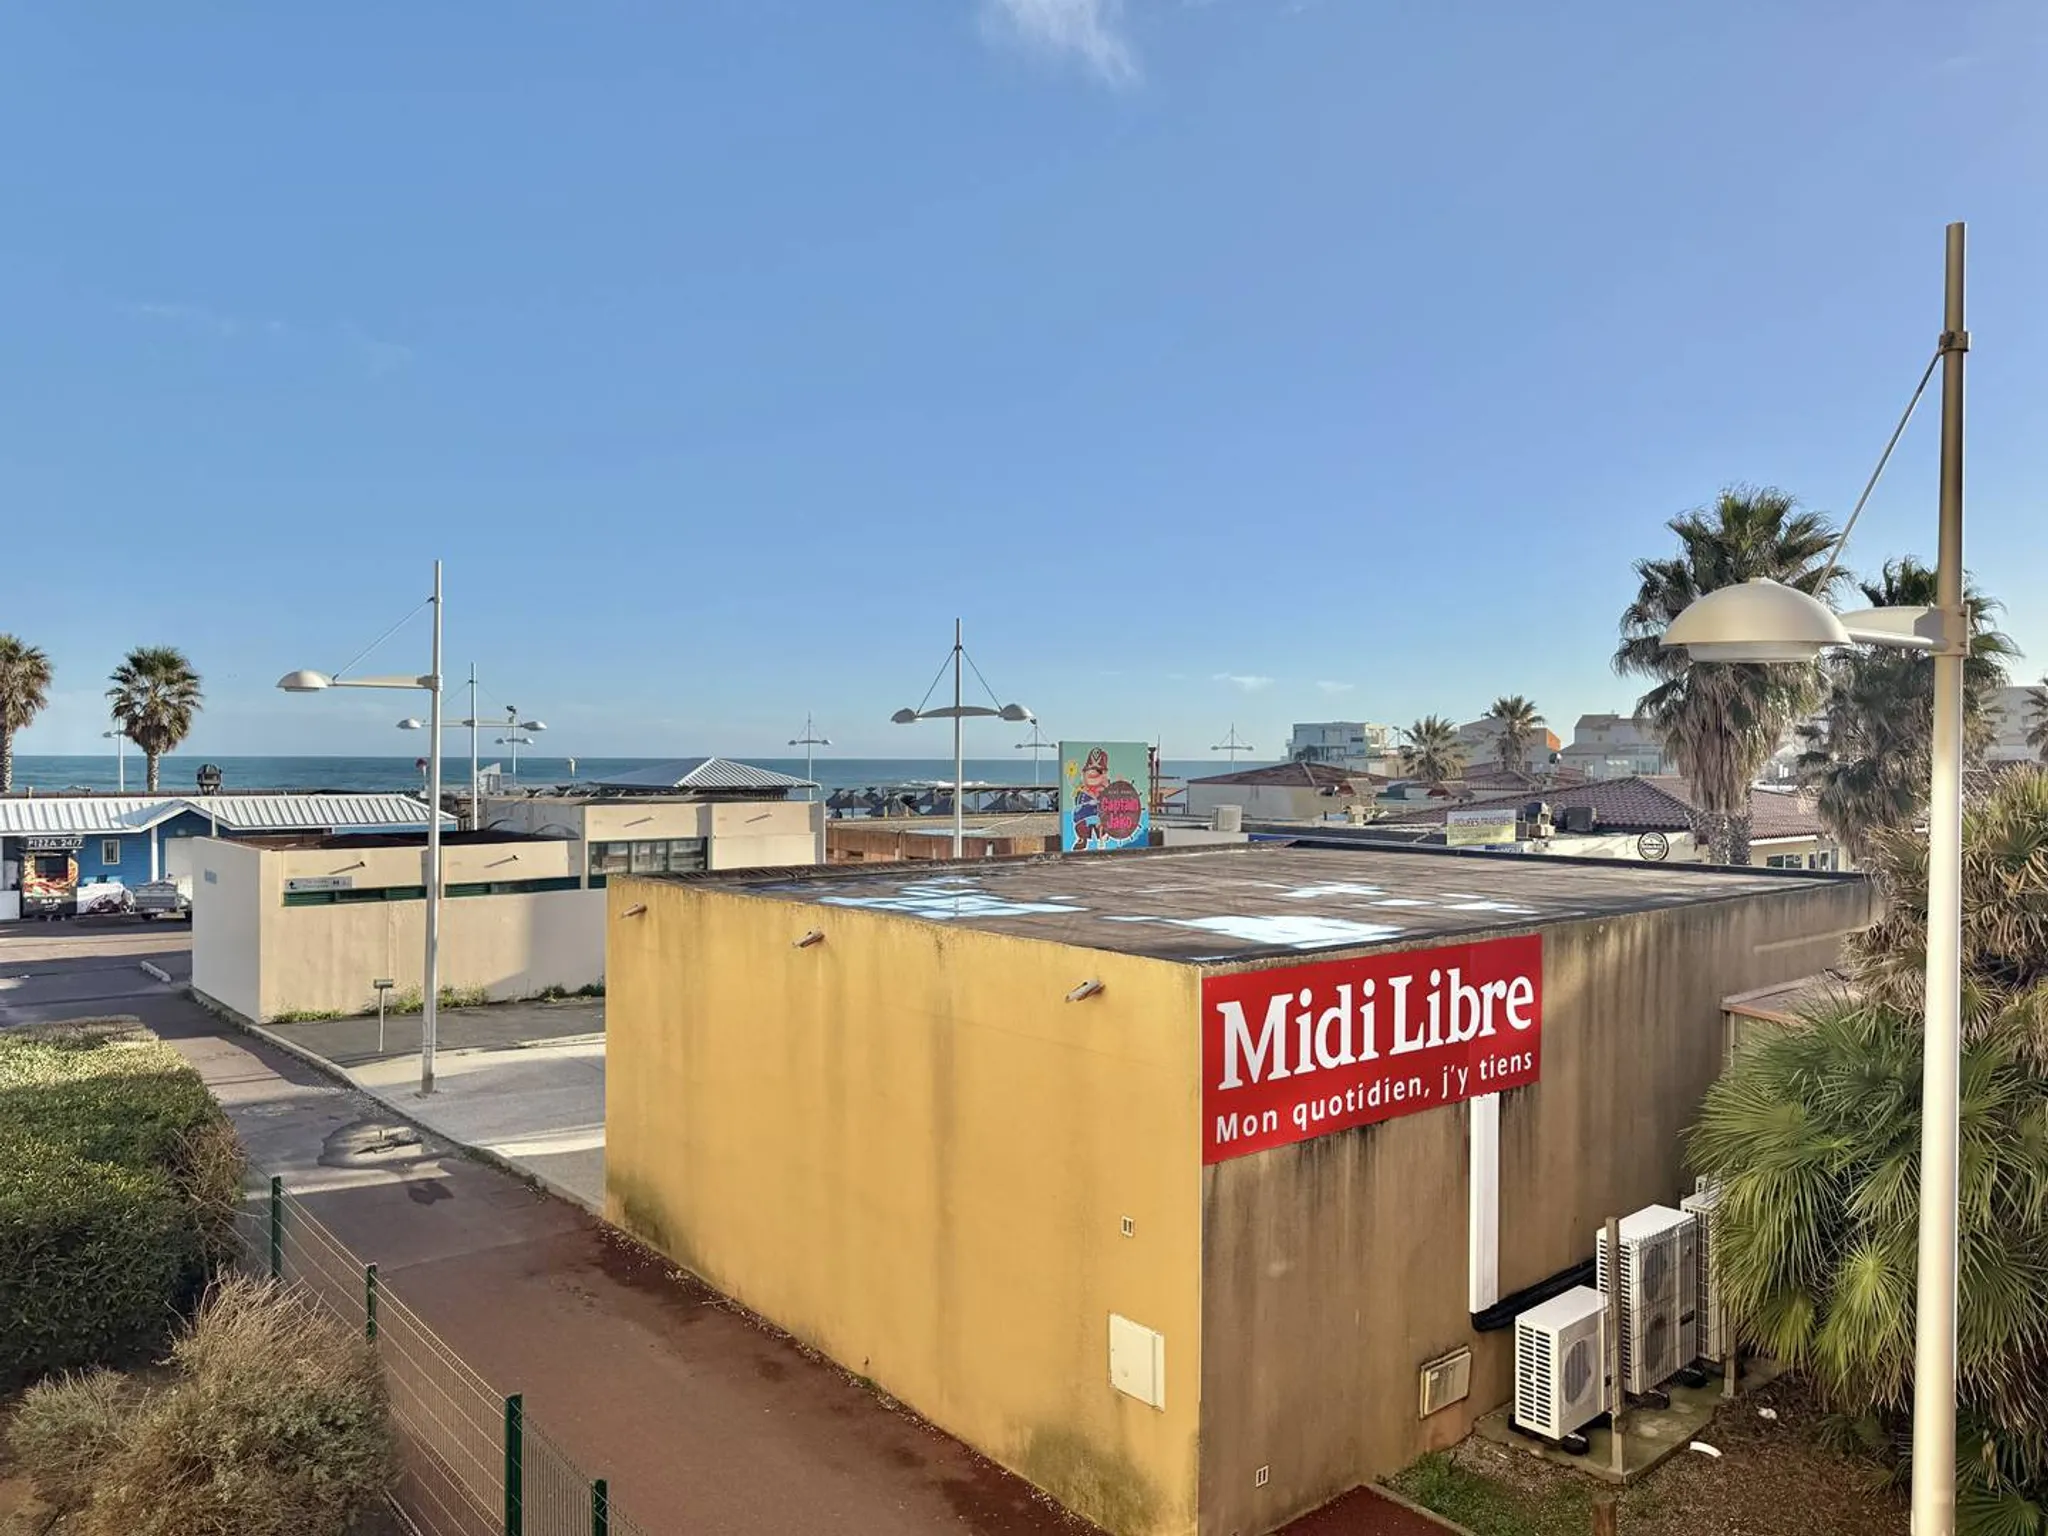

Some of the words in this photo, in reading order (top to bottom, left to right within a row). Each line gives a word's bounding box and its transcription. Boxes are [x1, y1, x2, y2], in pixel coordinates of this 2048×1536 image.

[28, 839, 57, 847] PIZZA
[1216, 978, 1380, 1091] Midi
[1388, 967, 1534, 1056] Libre
[1216, 1107, 1278, 1144] Mon
[1292, 1076, 1430, 1131] quotidien,
[1441, 1065, 1469, 1098] j'y
[1479, 1051, 1532, 1081] tiens
